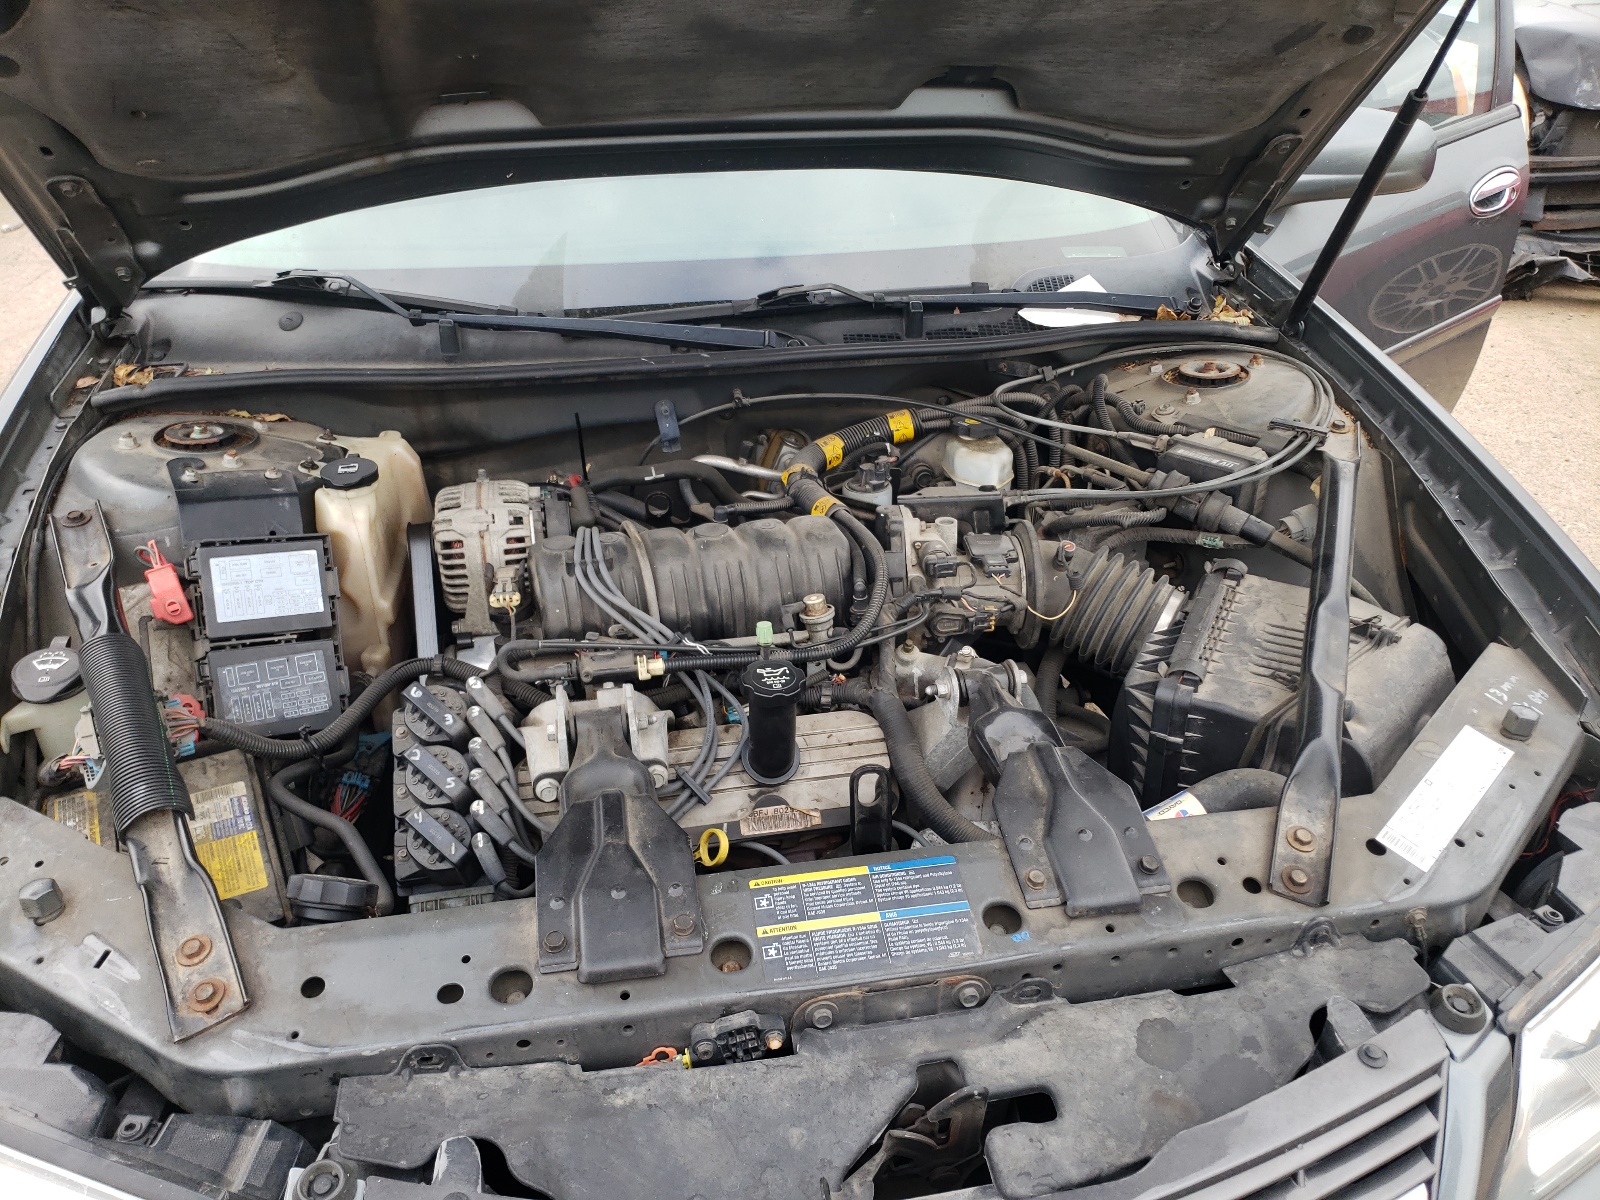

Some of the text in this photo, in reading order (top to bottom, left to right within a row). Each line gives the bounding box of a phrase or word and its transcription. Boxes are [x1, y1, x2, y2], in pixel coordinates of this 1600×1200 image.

[410, 686, 422, 698] 6
[444, 713, 453, 725] 3
[445, 777, 456, 788] 5
[414, 811, 423, 823] 4
[769, 924, 797, 933] ATTENTION
